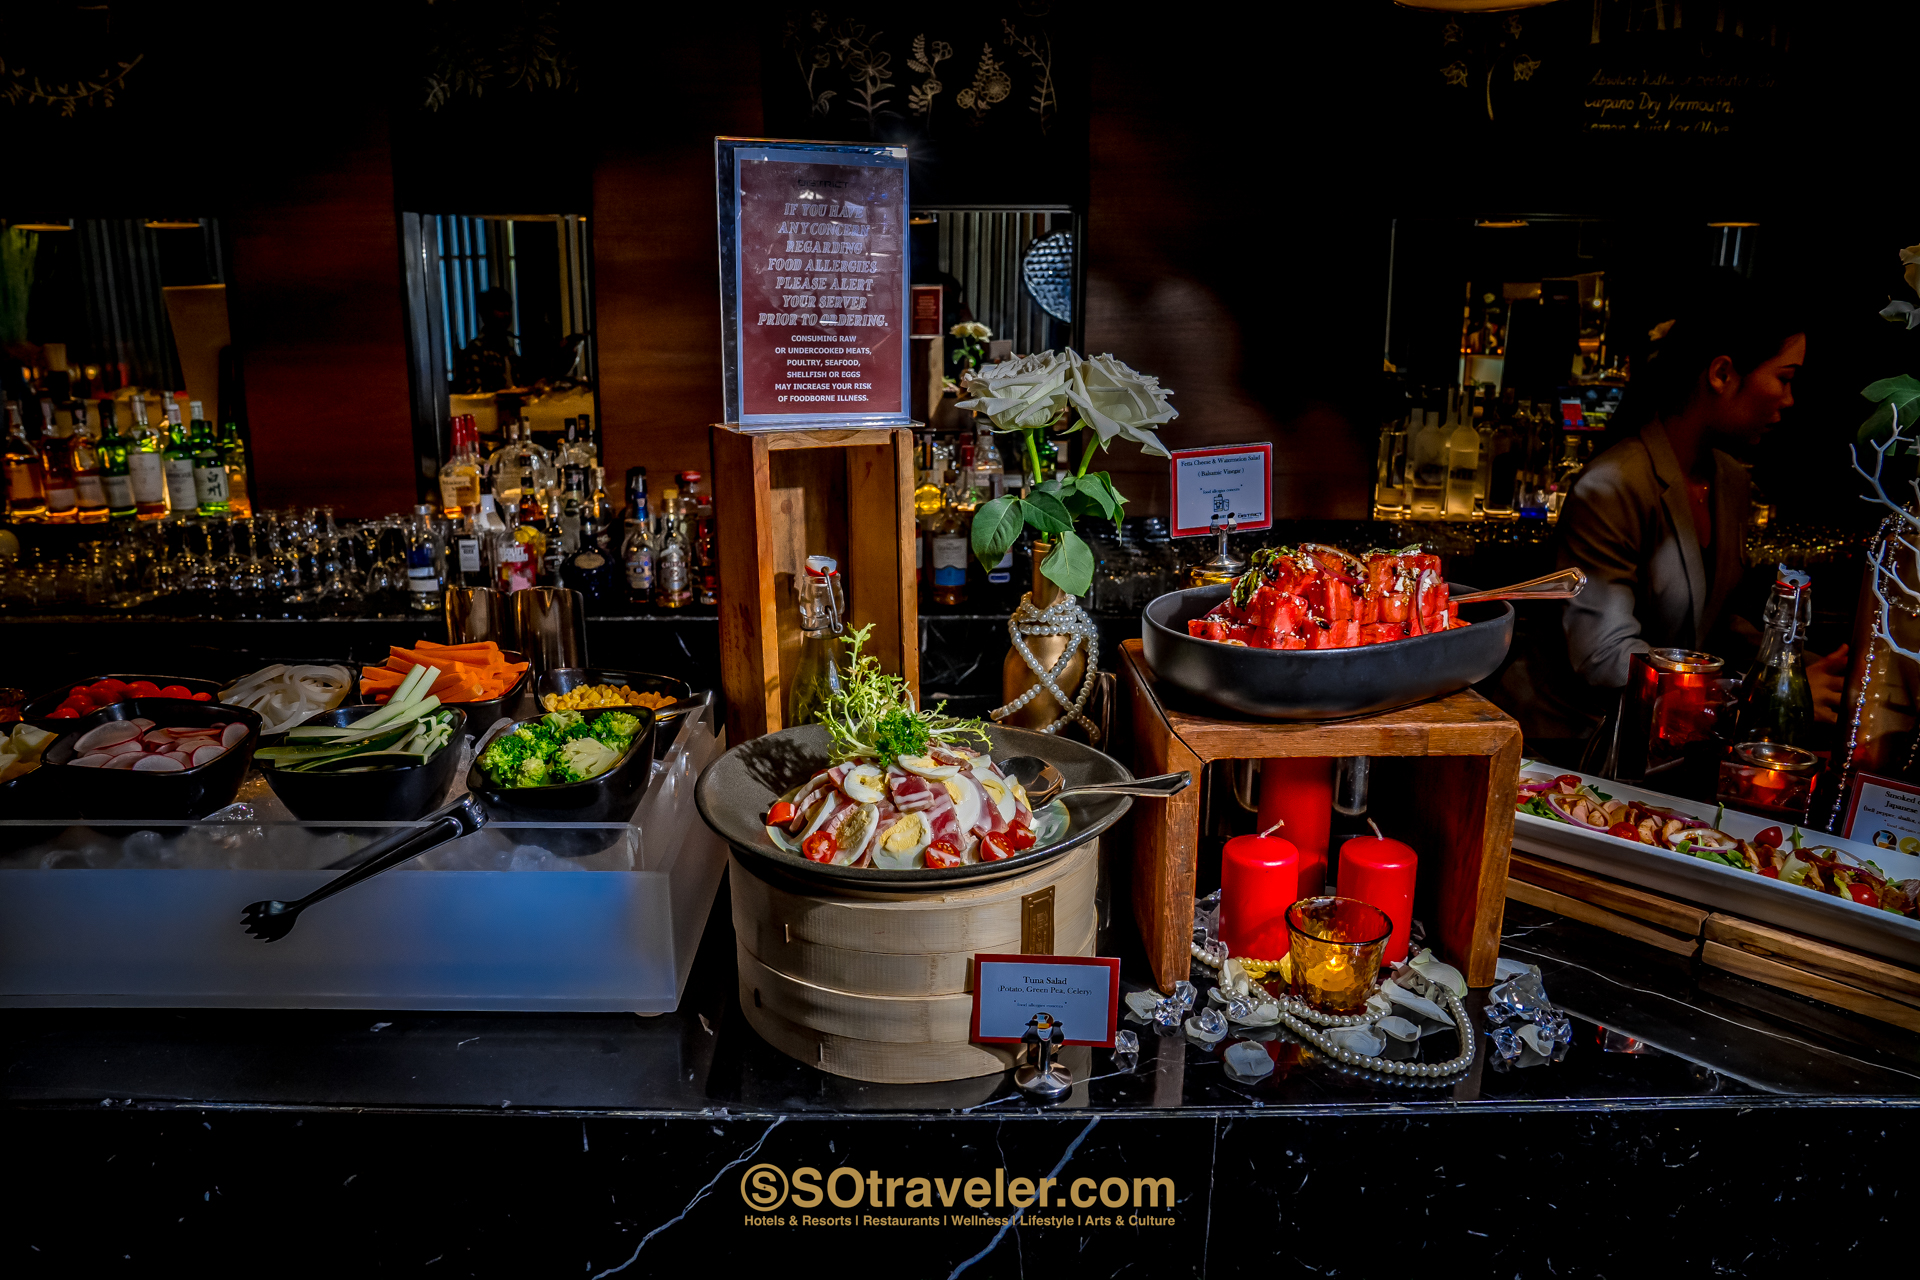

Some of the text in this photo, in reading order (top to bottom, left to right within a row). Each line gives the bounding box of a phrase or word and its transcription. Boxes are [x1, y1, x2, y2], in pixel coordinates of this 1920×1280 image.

[1638, 91, 1662, 120] Dry
[784, 202, 865, 218] IF YOU HAVE
[778, 221, 871, 237] ANY CONCERN
[785, 240, 863, 254] REGARDING
[767, 257, 878, 274] FOOD ALLERGIES
[775, 276, 874, 291] PLEASE ALERT
[782, 295, 868, 309] YOUR SERVER
[757, 312, 889, 327] PRIOR TO ORDERING.
[845, 347, 872, 355] MEATS,
[786, 359, 861, 367] POULTRY, SEAFOOD,
[854, 382, 872, 390] RISK
[836, 394, 869, 402] ILLNESS.
[1885, 791, 1916, 804] Smoked
[1885, 800, 1918, 813] Japanese
[1023, 976, 1067, 985] Tuna Salad
[1067, 987, 1092, 996] Celery)
